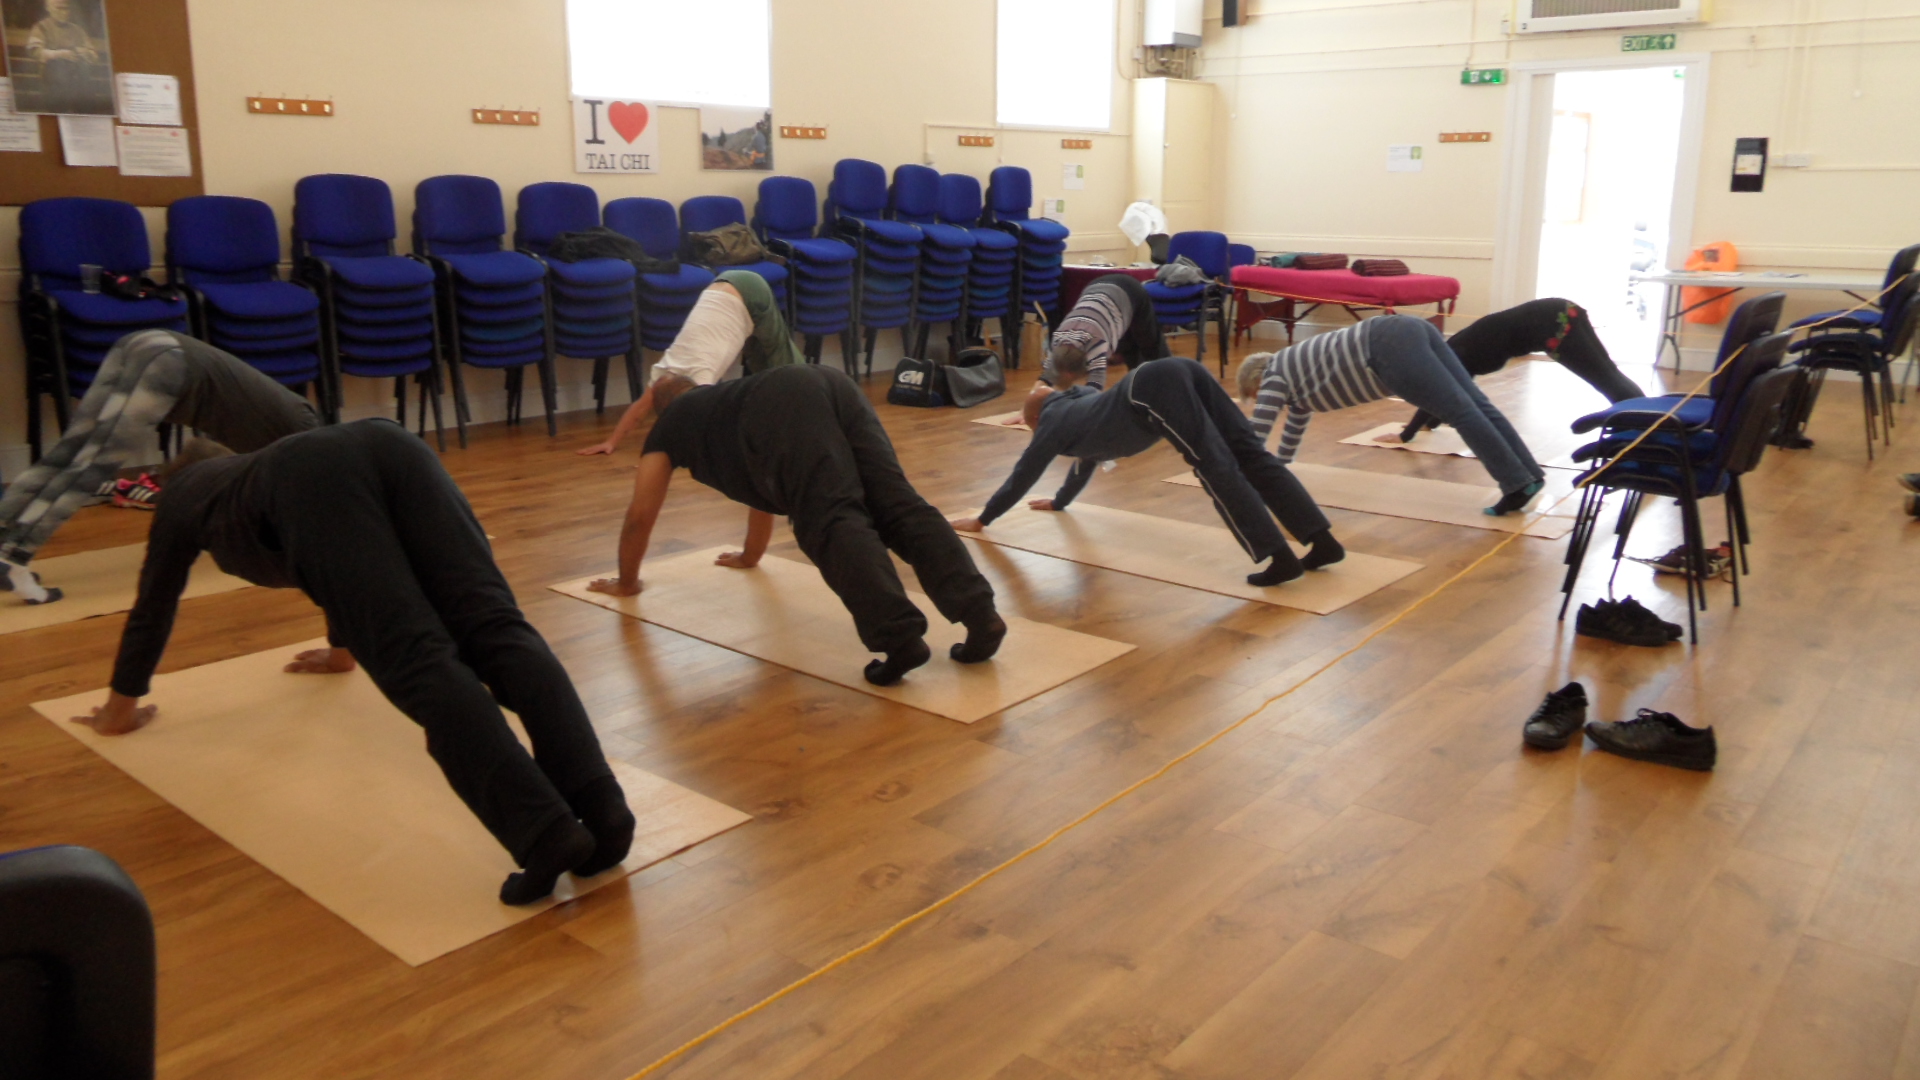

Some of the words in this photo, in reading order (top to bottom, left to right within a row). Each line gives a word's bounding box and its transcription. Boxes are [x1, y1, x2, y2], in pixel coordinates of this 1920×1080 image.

[1624, 36, 1650, 51] EXIT
[583, 99, 605, 145] I
[586, 153, 616, 170] TAI
[620, 153, 650, 170] CHI
